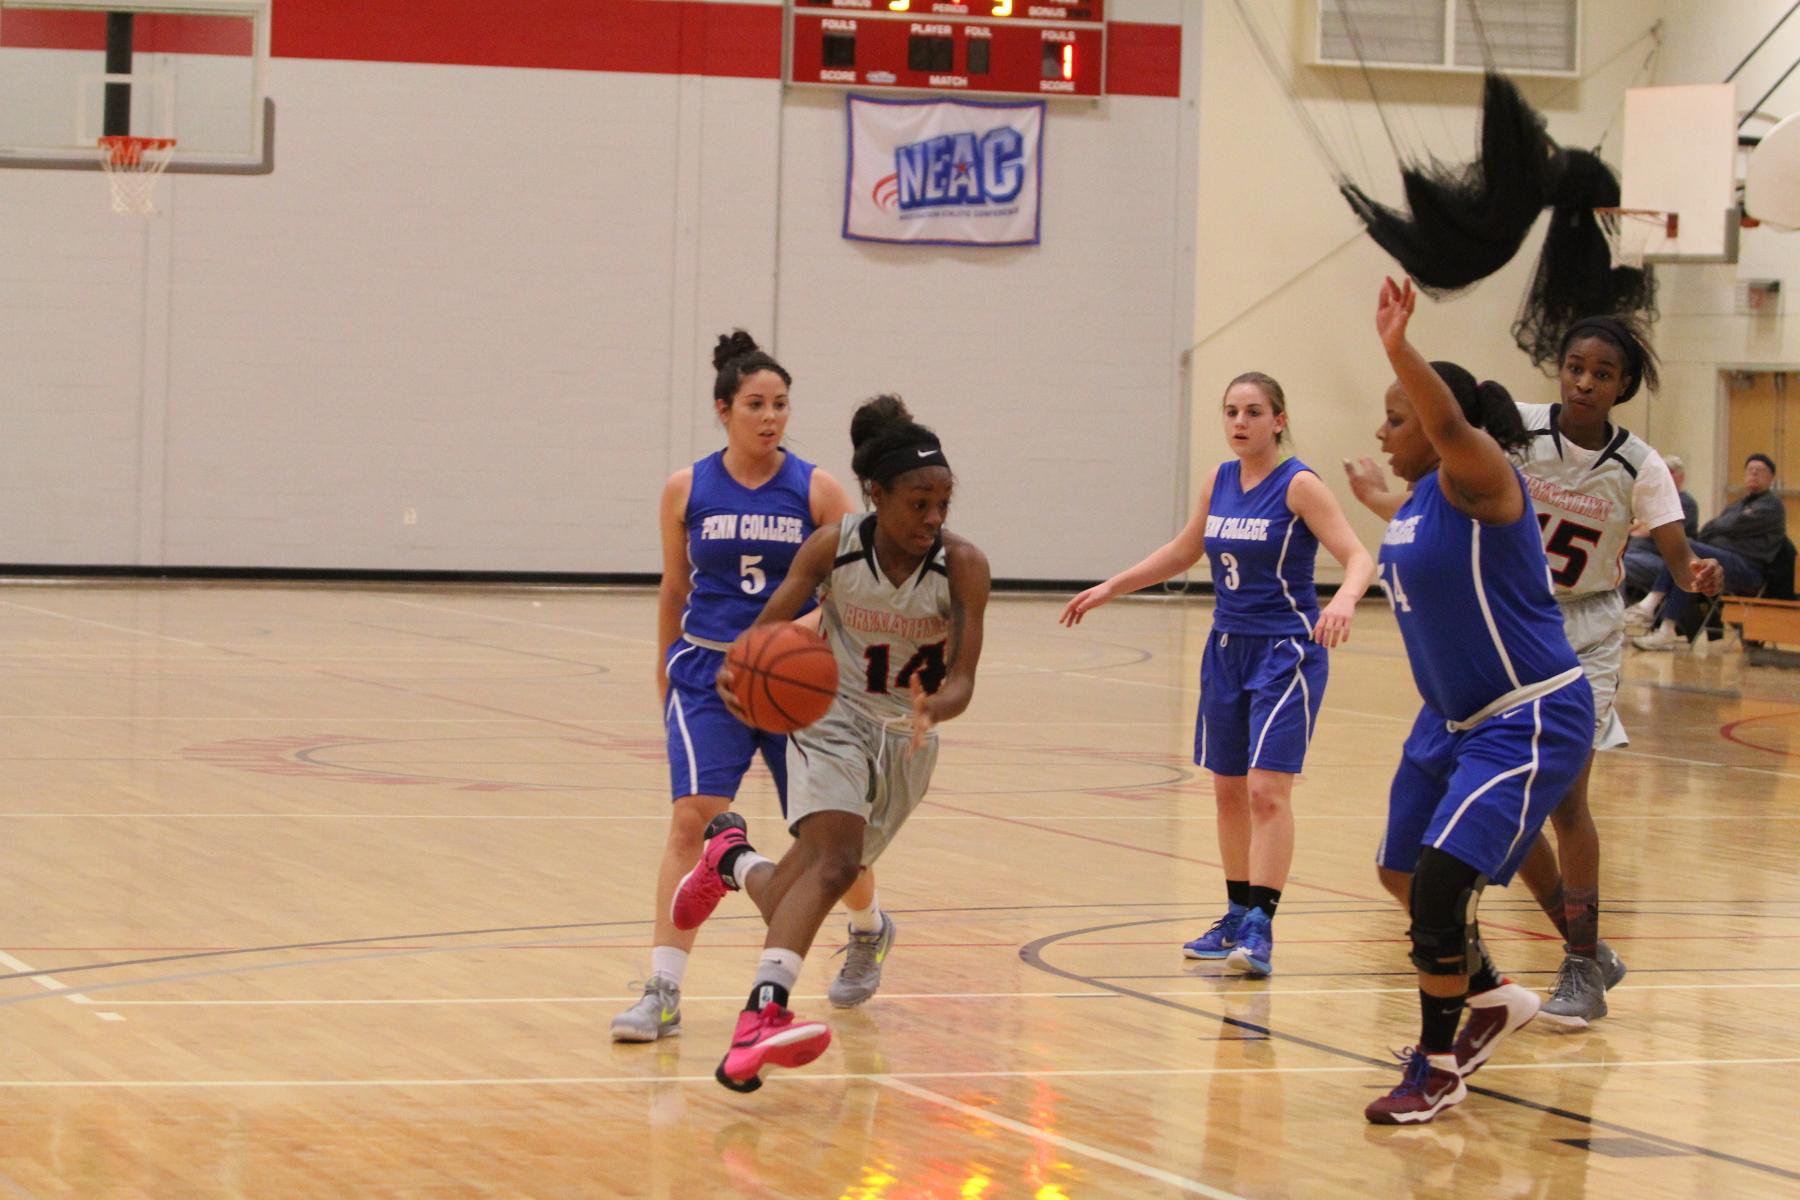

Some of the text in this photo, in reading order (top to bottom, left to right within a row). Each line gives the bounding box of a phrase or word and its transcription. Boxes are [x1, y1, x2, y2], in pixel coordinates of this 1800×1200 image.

[932, 3, 969, 14] PERIOD
[1028, 6, 1067, 18] BONUS
[822, 18, 857, 31] FOULS
[910, 23, 952, 35] PLAYER
[965, 26, 992, 38] FOUL
[1041, 30, 1076, 42] FOULS
[1062, 44, 1073, 80] 1
[820, 70, 856, 81] SCORE
[929, 75, 968, 87] MATCH
[1040, 80, 1075, 92] SCORE
[895, 126, 1024, 211] NEAC
[701, 514, 803, 544] PENN COLLEGE
[1204, 515, 1271, 541] ENN COLLEGE
[740, 554, 766, 595] 5
[1220, 552, 1240, 591] 3
[864, 638, 947, 696] 14
